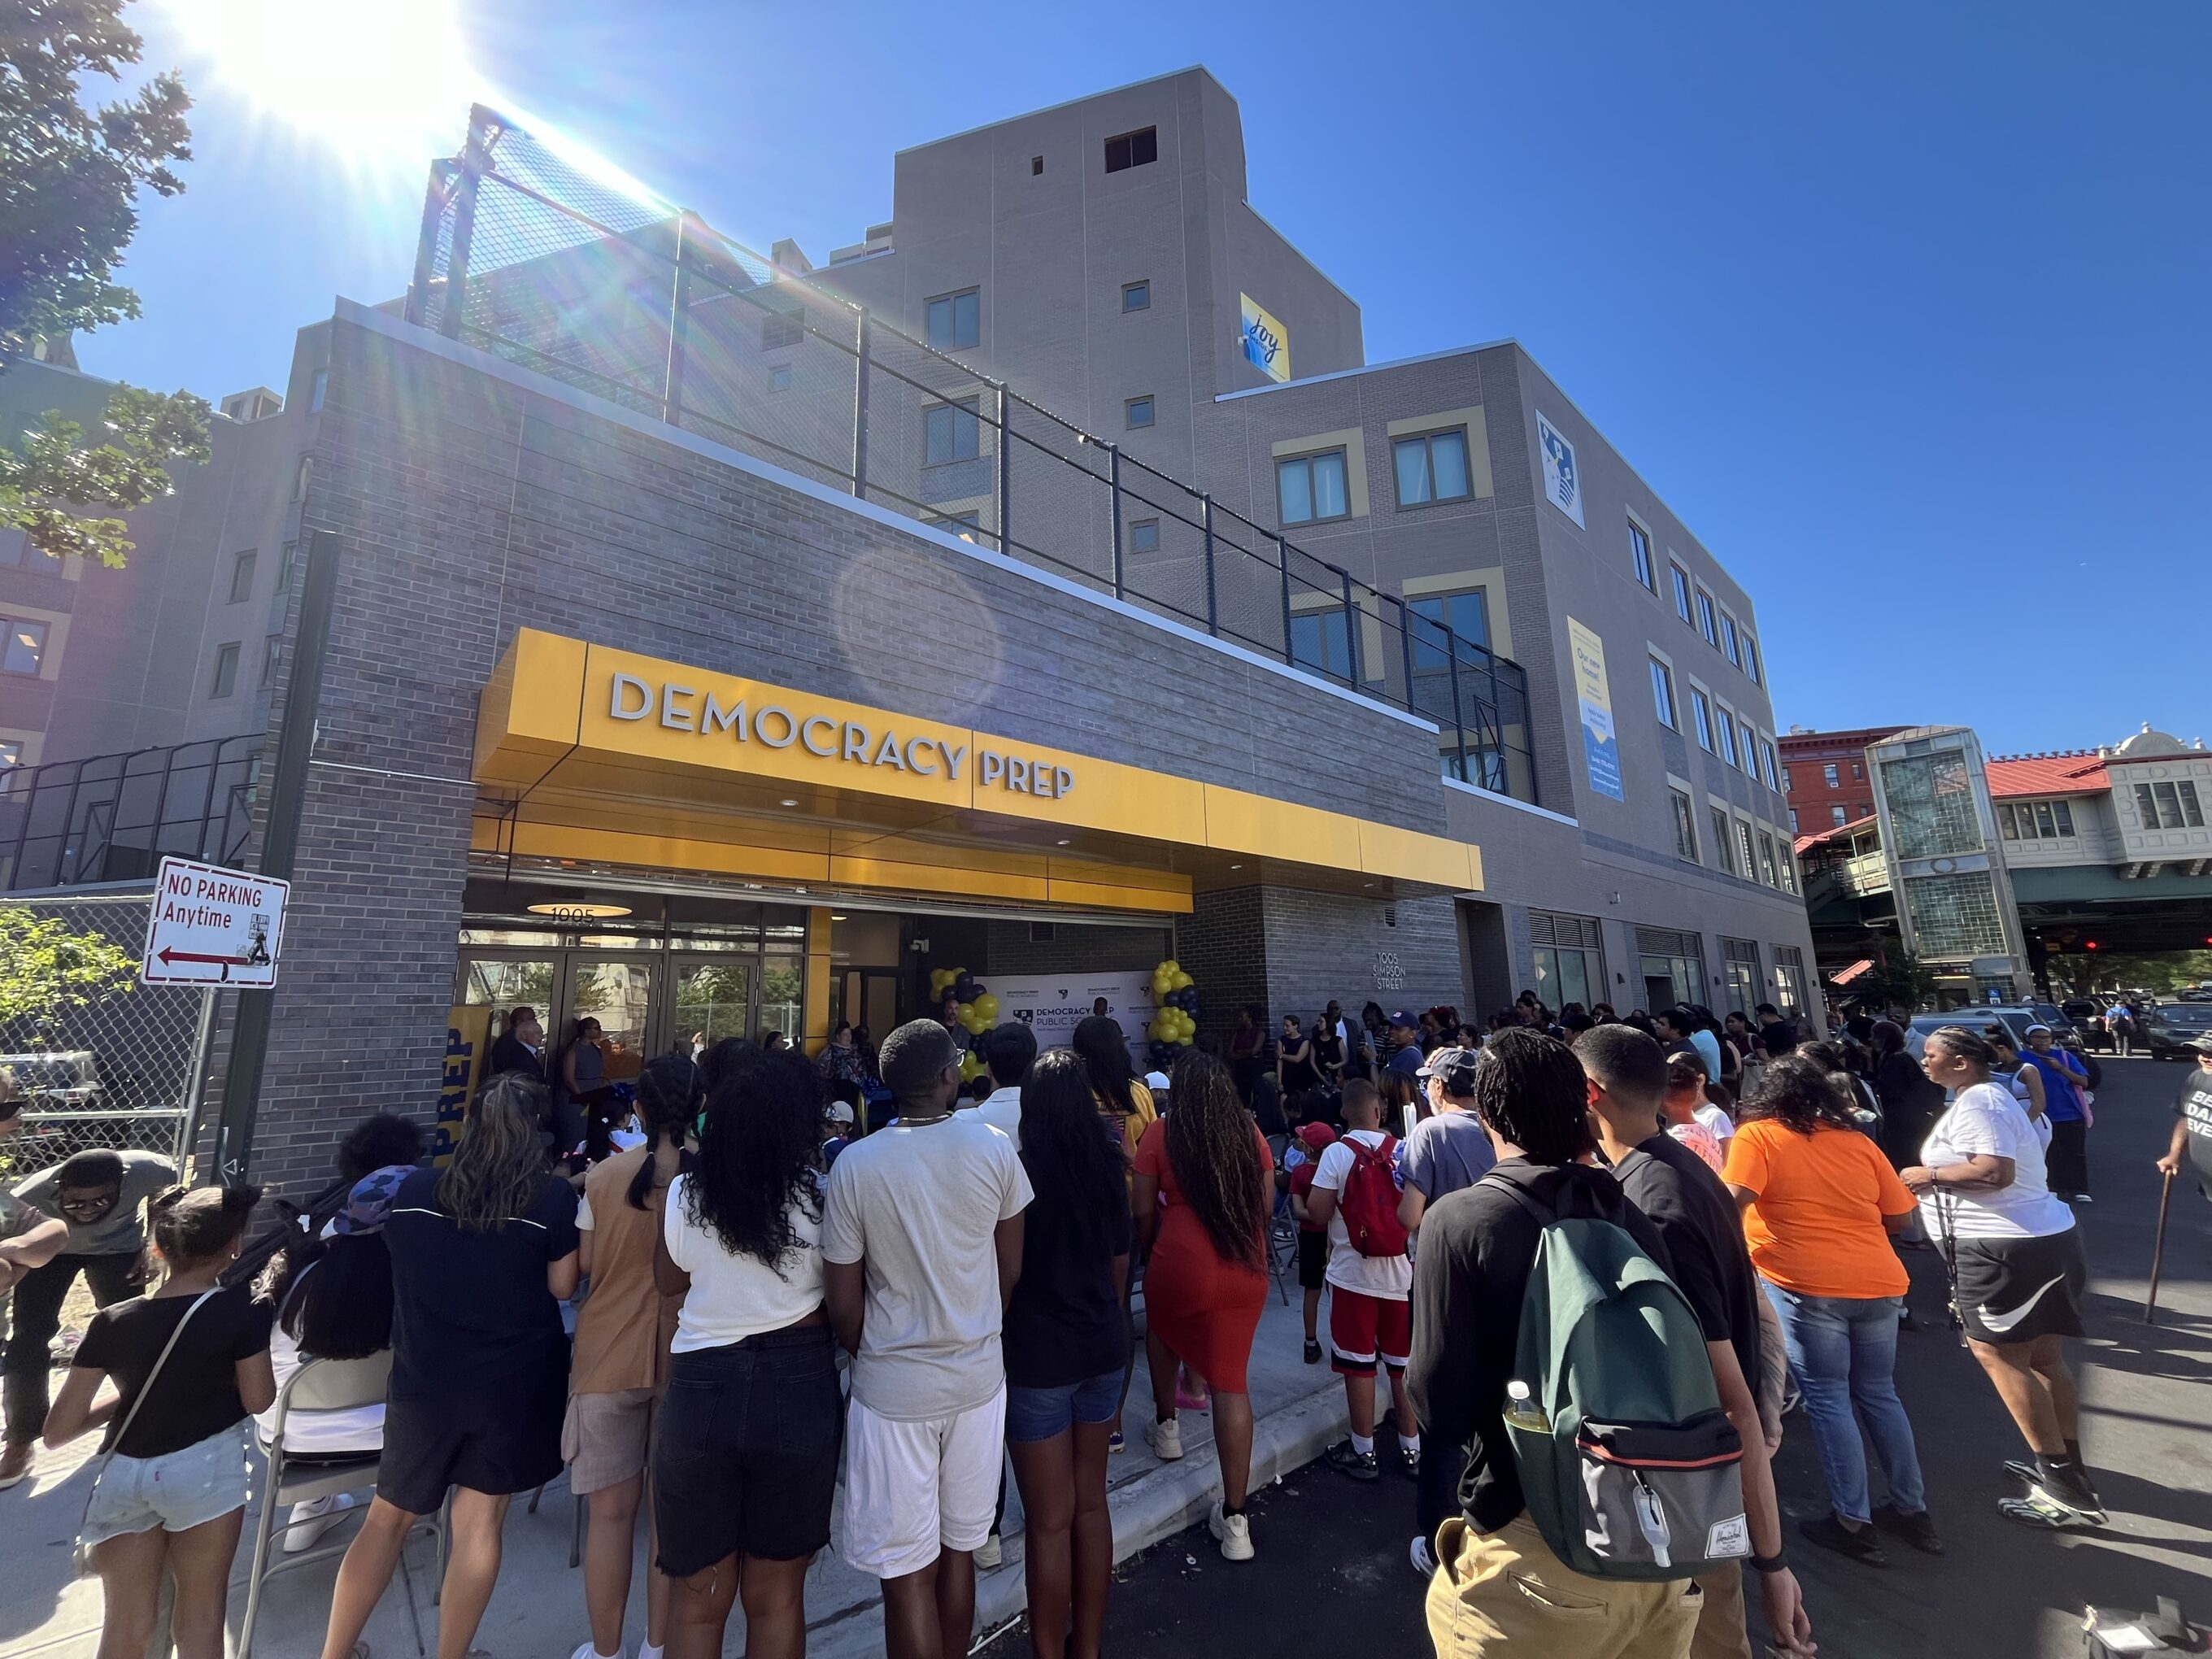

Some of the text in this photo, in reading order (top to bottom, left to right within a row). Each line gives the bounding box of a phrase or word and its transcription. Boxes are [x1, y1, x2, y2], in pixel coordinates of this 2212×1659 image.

[1249, 314, 1282, 364] joy
[610, 673, 1075, 799] DEMOCRACY PREP
[168, 874, 262, 908] NO PARKING
[163, 901, 232, 929] Anytime
[551, 908, 594, 922] 1005
[1378, 952, 1398, 964] 1005
[1372, 964, 1406, 977] SIMPSON
[1377, 978, 1404, 990] STREET
[1036, 1008, 1091, 1016] DEMOCRACY
[1036, 1017, 1068, 1025] PUBLIC
[432, 1028, 472, 1156] PREP
[2186, 1103, 2212, 1123] DA
